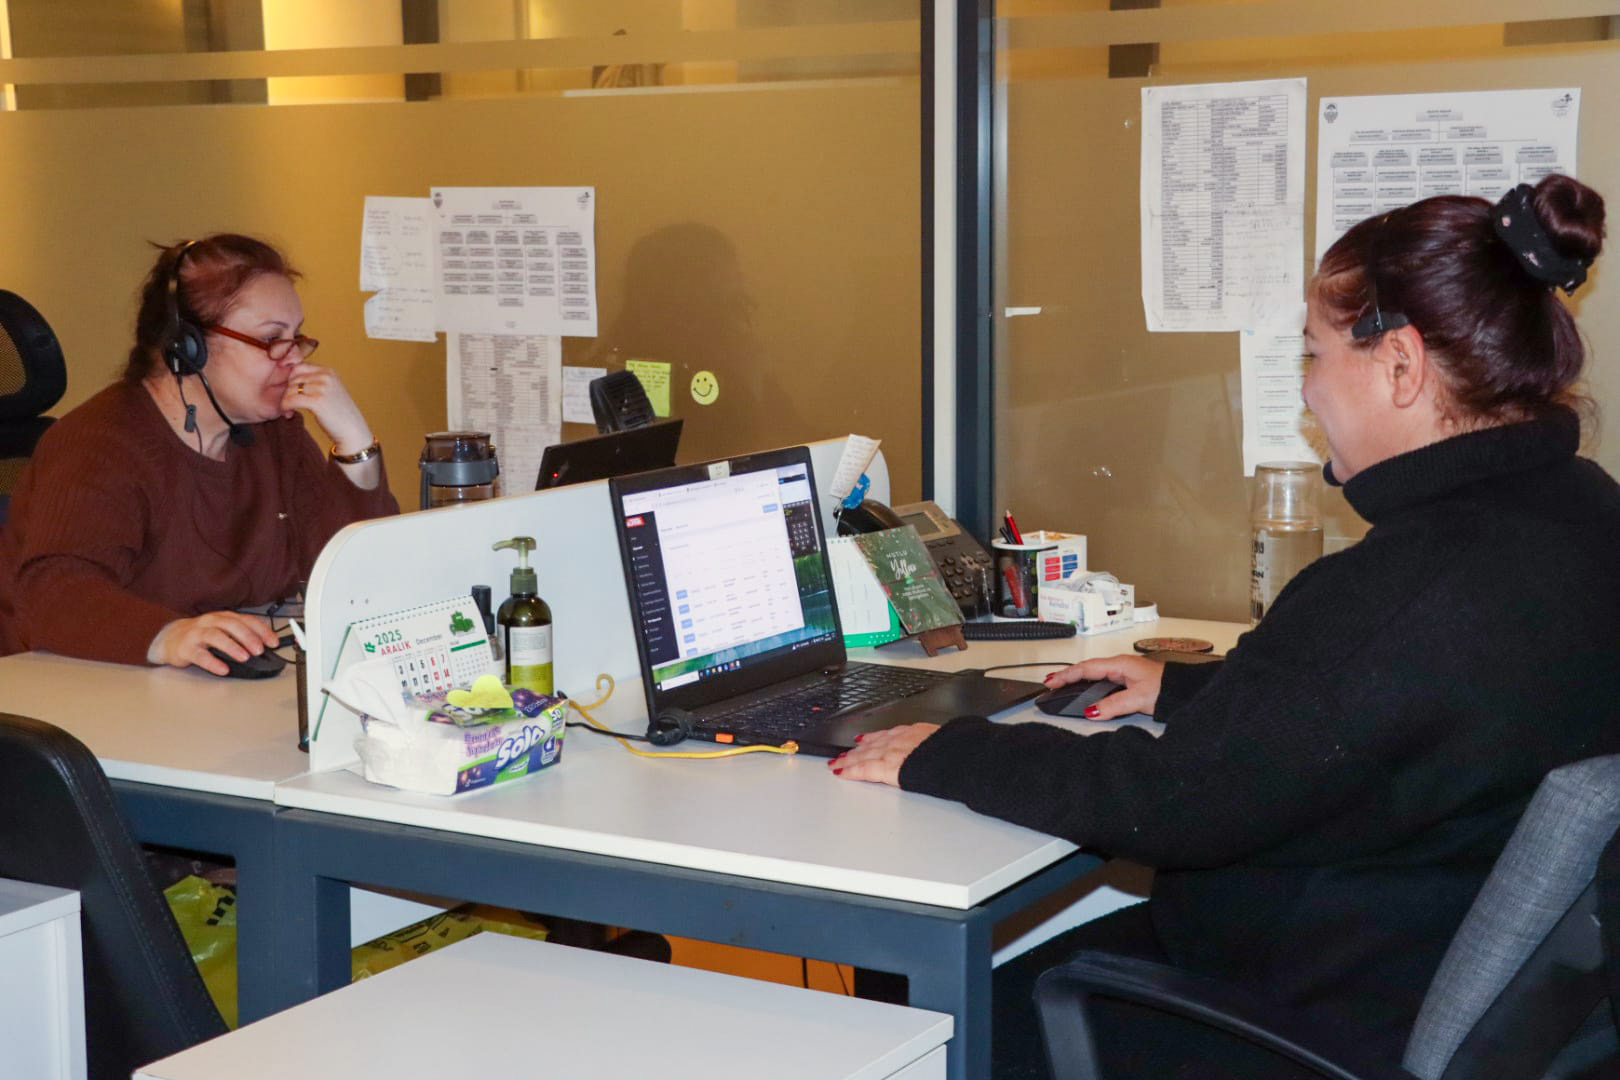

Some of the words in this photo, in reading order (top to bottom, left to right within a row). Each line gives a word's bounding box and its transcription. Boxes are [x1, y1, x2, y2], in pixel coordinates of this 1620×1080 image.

[374, 629, 402, 645] 2025
[415, 634, 442, 645] December
[381, 640, 411, 656] ARALIK
[494, 724, 546, 770] Solo
